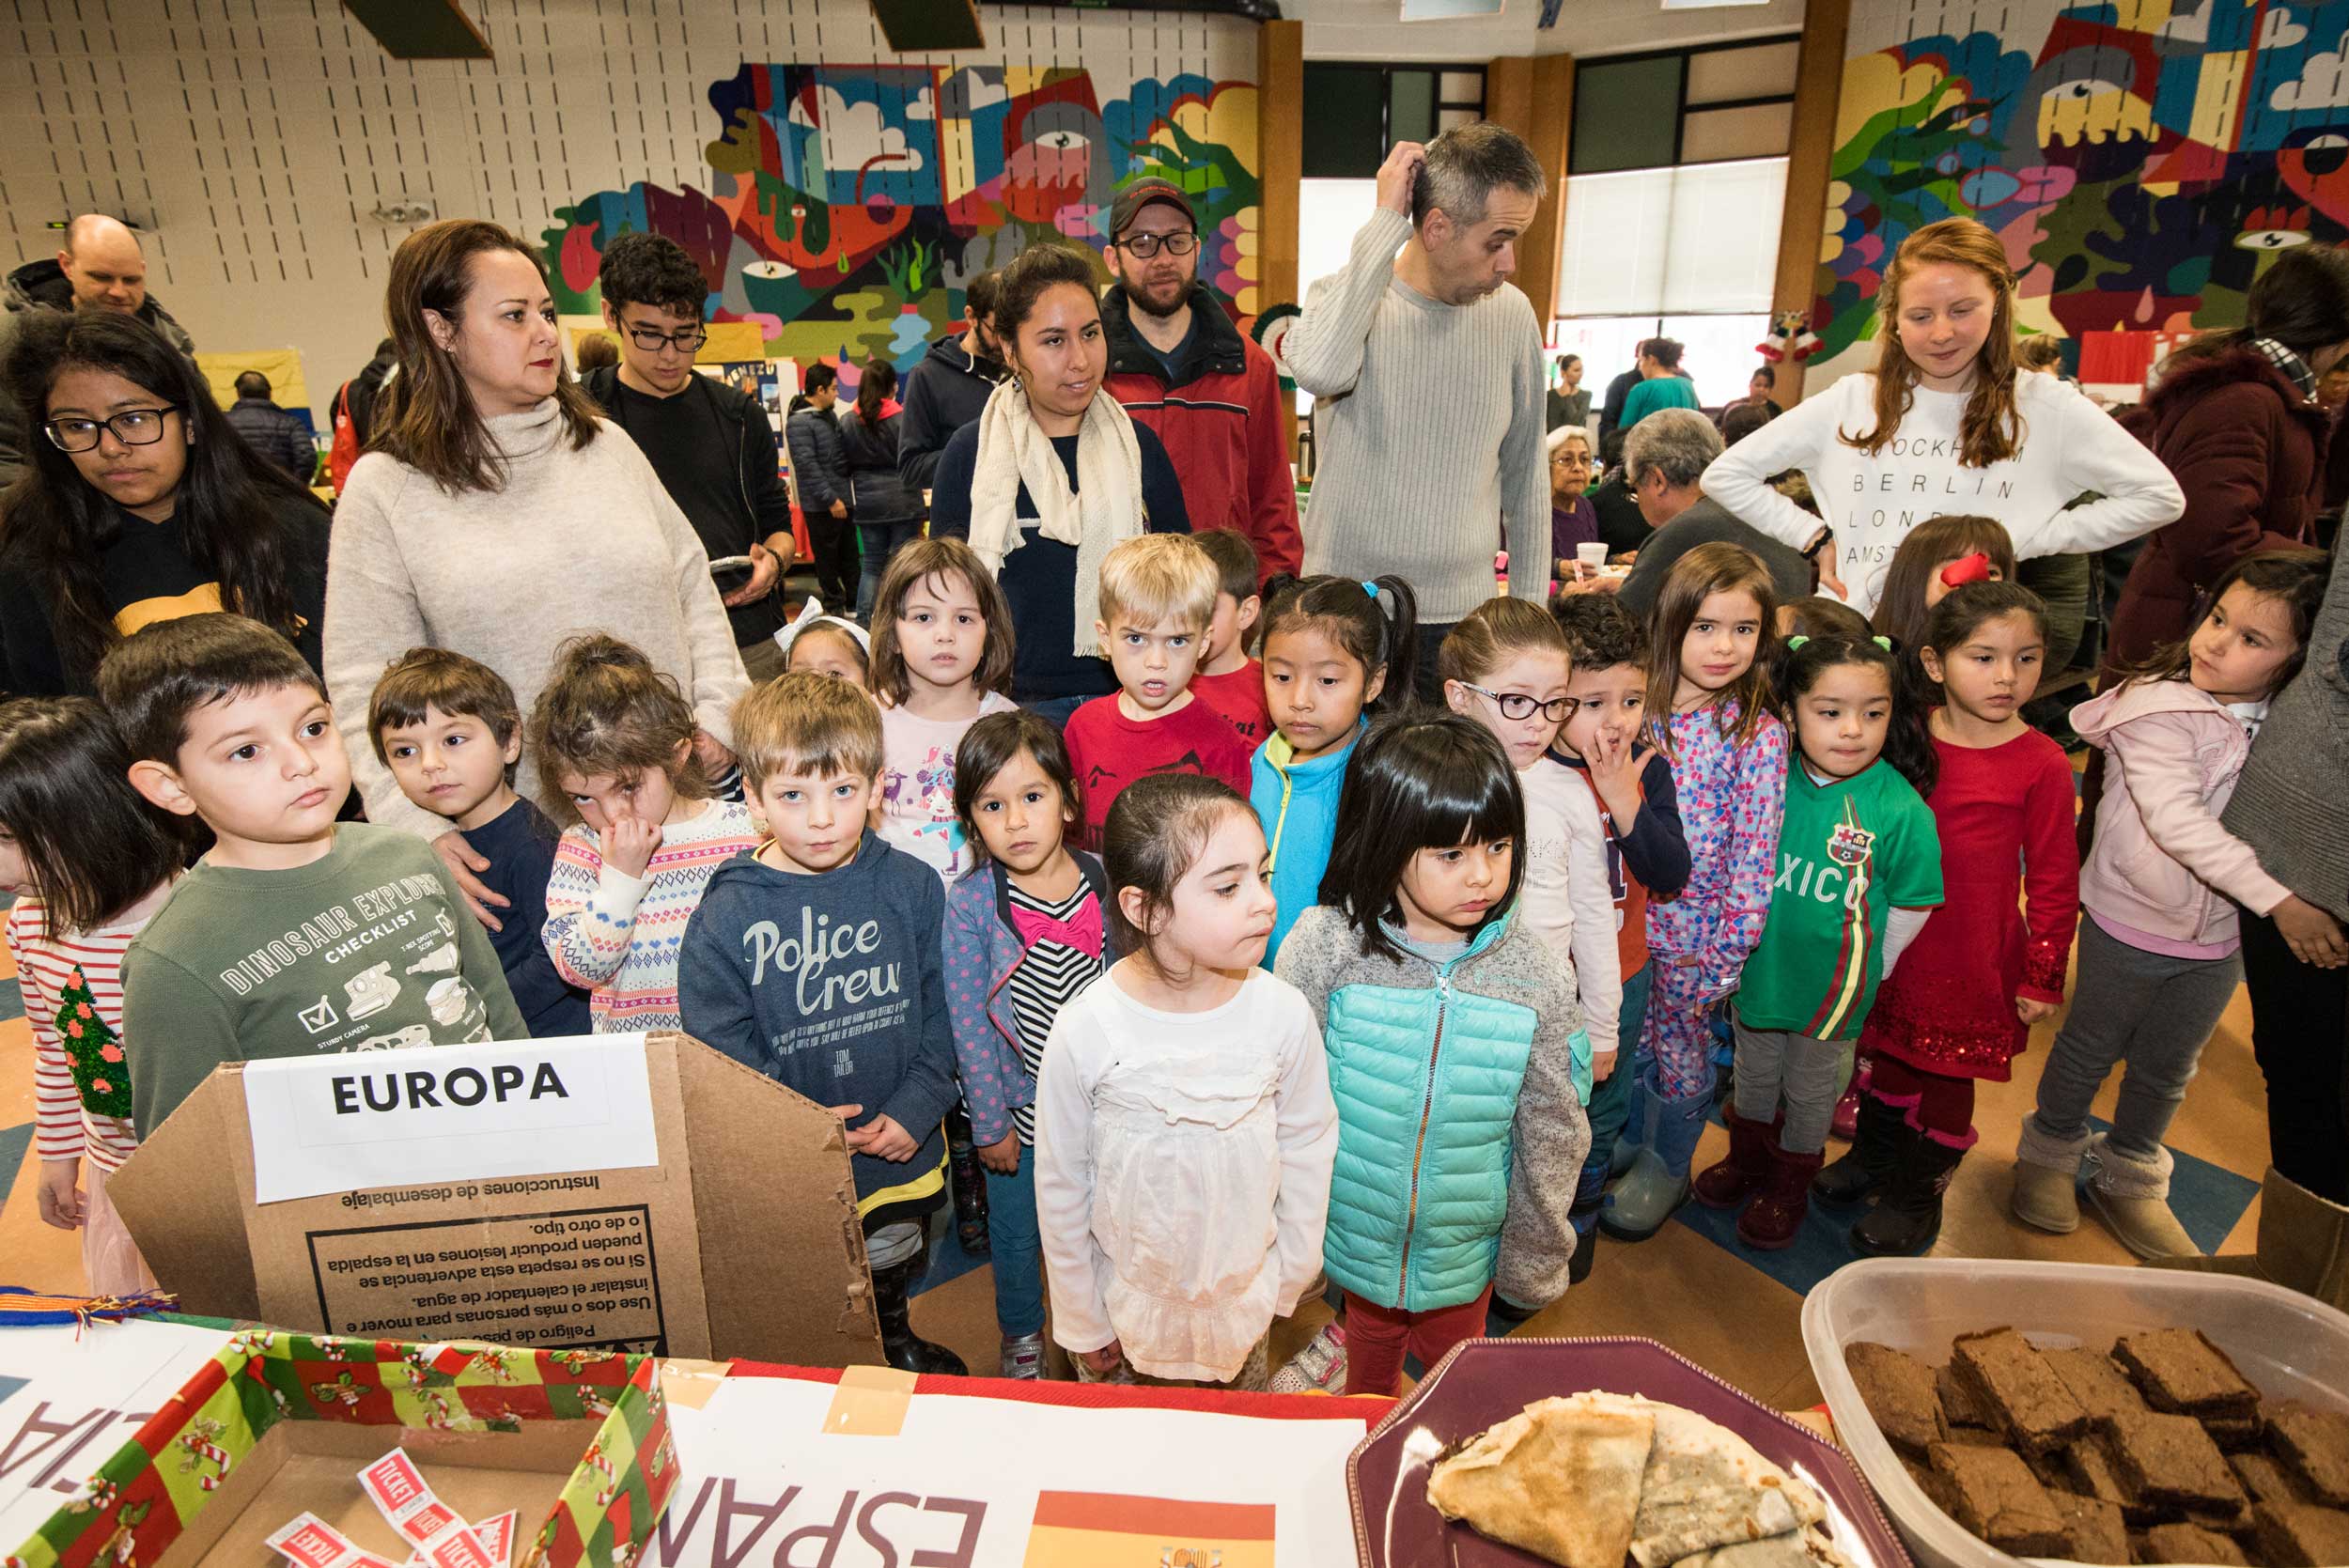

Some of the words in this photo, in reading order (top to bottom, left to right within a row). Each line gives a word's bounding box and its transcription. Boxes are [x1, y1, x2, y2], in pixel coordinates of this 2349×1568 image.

[1854, 474, 2014, 499] BERLIN
[1774, 853, 1870, 909] XICO
[325, 909, 419, 965] CHECKLIST
[416, 927, 441, 944] SPOTTING
[220, 906, 358, 996] DINOSAUR
[743, 906, 882, 986] Police
[318, 1034, 343, 1049] STURDY
[342, 1023, 370, 1041] CAMERA
[835, 1048, 849, 1064] TOM
[833, 1061, 854, 1079] TAILOR
[332, 1062, 569, 1114] EUROPA
[484, 1175, 599, 1195] Instrucciones
[341, 1187, 453, 1210] desembalaje
[456, 1186, 478, 1201] de
[529, 1220, 566, 1235] tipo.
[568, 1219, 601, 1234] otro
[604, 1217, 626, 1232] de
[629, 1216, 640, 1227] o
[509, 1237, 579, 1259] producir
[582, 1233, 643, 1250] pueden
[395, 1254, 411, 1268] la
[414, 1252, 435, 1265] en
[439, 1248, 507, 1261] lesiones
[603, 1255, 625, 1266] no
[629, 1253, 646, 1268] Si
[328, 1254, 393, 1274] espalda
[518, 1260, 578, 1276] respeta
[581, 1257, 600, 1269] se
[382, 1267, 476, 1289] advertencia
[480, 1265, 515, 1278] esta
[359, 1277, 380, 1289] se
[572, 1281, 586, 1294] el
[590, 1278, 649, 1294] instalar
[411, 1293, 458, 1309] agua.
[460, 1292, 481, 1304] de
[485, 1283, 569, 1303] calentador
[534, 1304, 568, 1318] más
[571, 1302, 583, 1312] o
[586, 1297, 616, 1312] dos
[620, 1296, 651, 1311] Use
[415, 1311, 451, 1327] para
[456, 1305, 530, 1322] personas
[345, 1322, 358, 1333] e
[360, 1318, 412, 1332] mover
[540, 1325, 596, 1341] Peligro
[516, 1328, 536, 1343] de
[376, 1460, 415, 1503] TICKET
[412, 1509, 446, 1534] TICKET
[289, 1529, 338, 1565] TICKET
